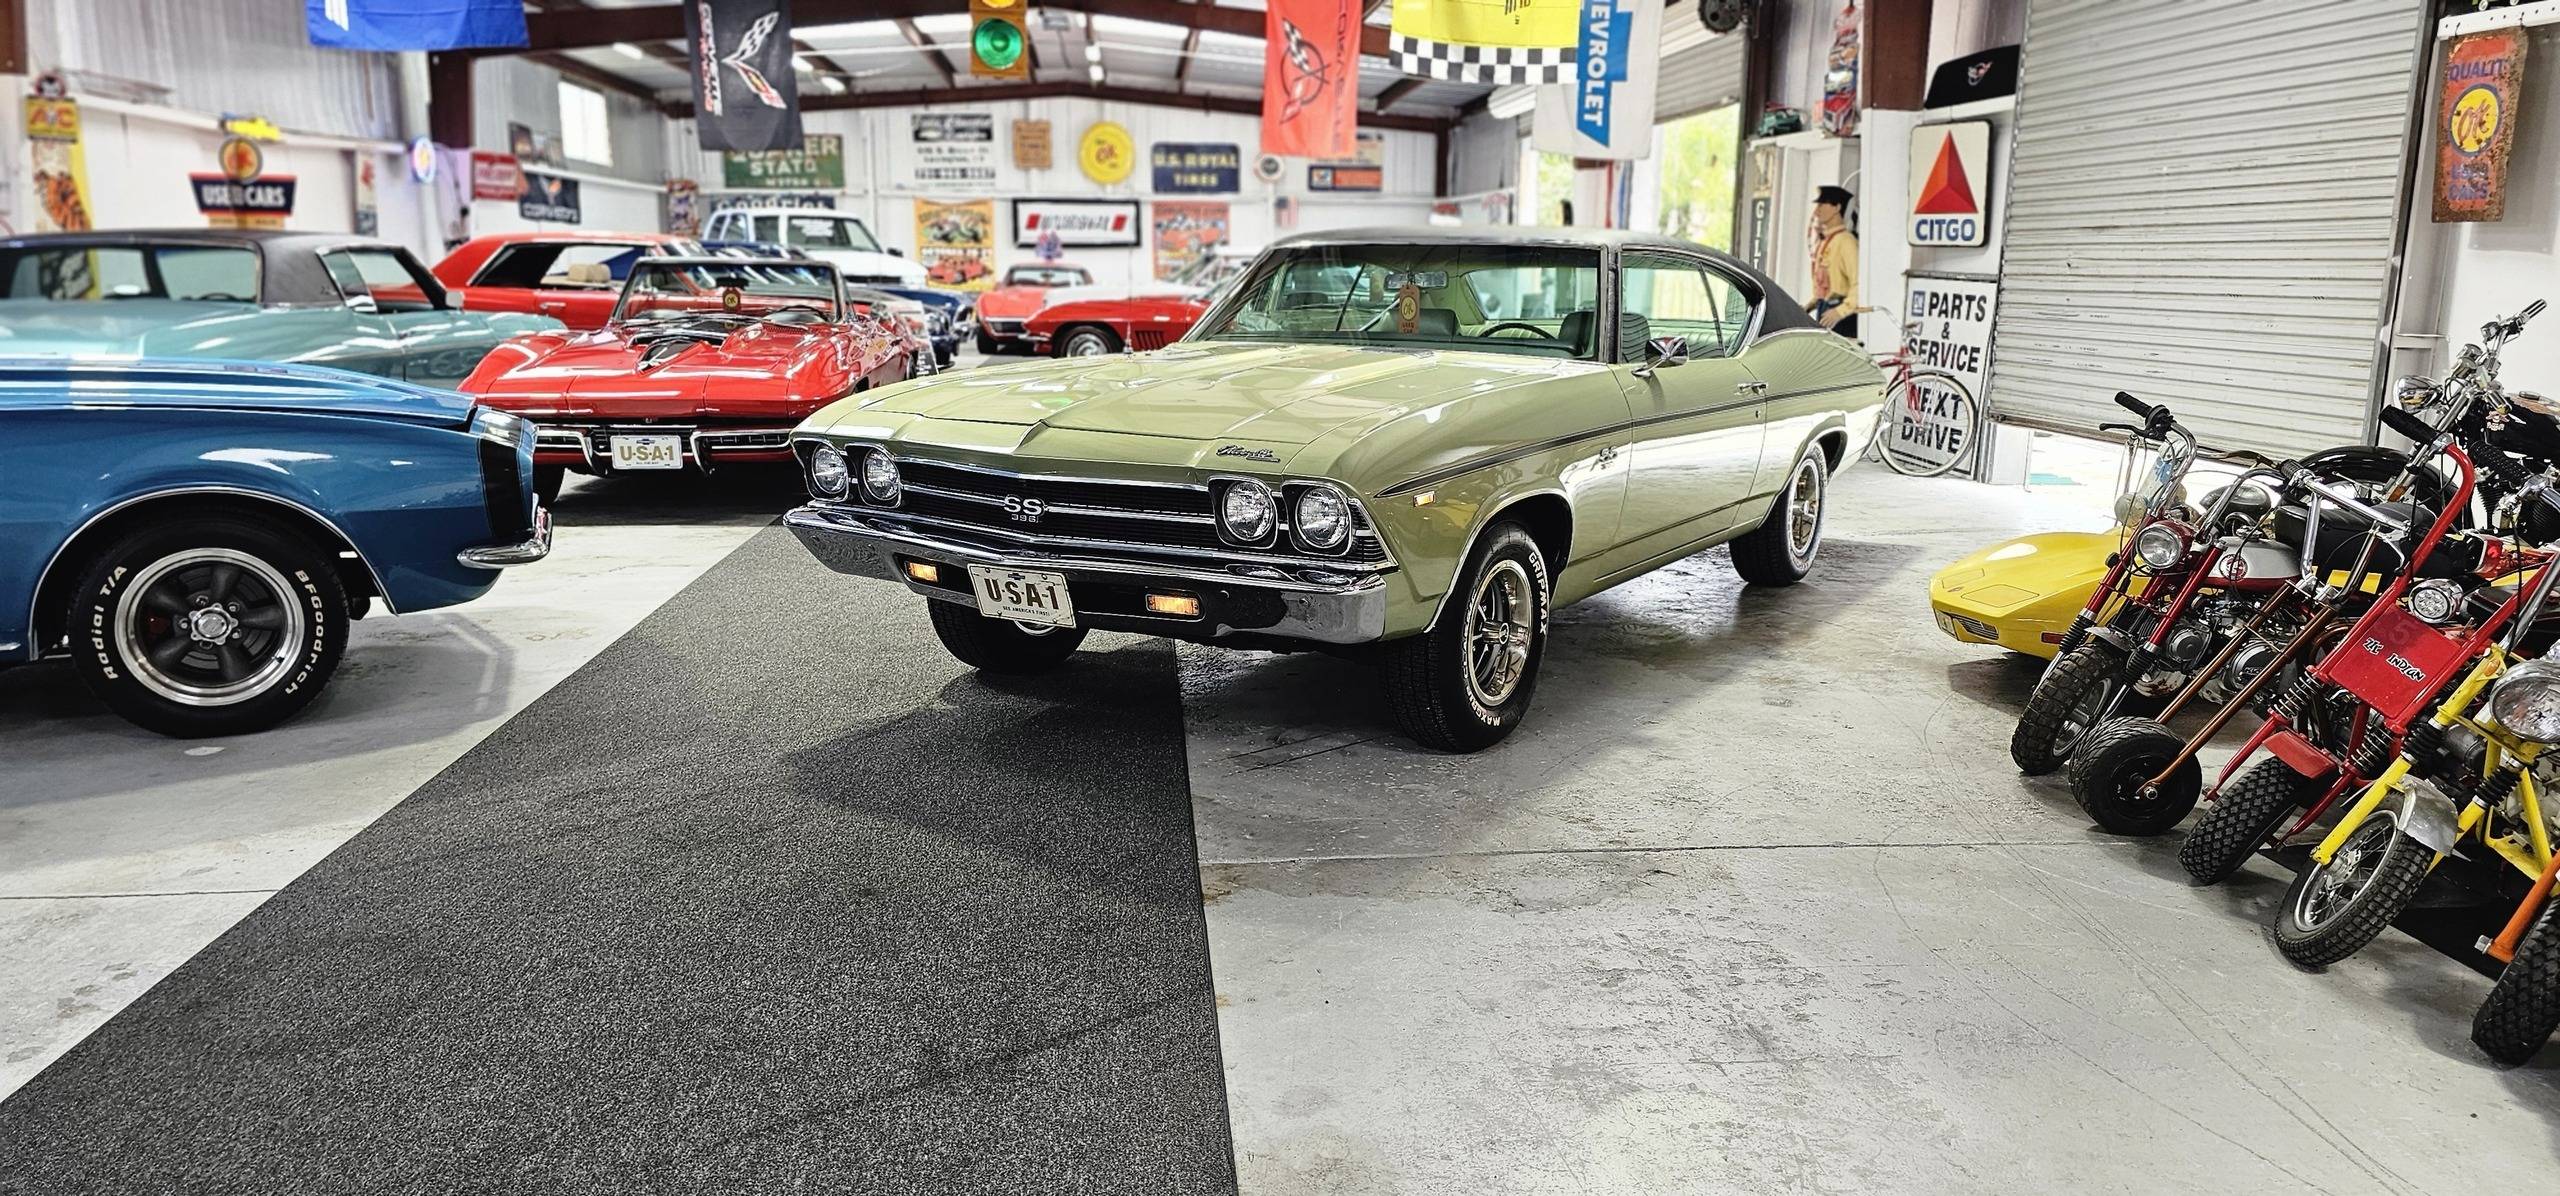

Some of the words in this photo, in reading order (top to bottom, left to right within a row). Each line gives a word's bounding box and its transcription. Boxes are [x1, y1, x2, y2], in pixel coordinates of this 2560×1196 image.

[700, 2, 722, 116] CORVETTE
[1583, 0, 1613, 127] EVROLET
[2449, 58, 2505, 81] QUALIT
[2457, 98, 2491, 146] OK
[1185, 153, 1238, 168] ROYAL
[2451, 163, 2490, 181] US
[201, 185, 244, 206] USED
[245, 186, 285, 207] CARS
[1173, 174, 1219, 187] TIRES
[1915, 218, 1976, 242] CITGO
[1928, 291, 1988, 322] PARTS
[1941, 321, 1950, 340] &
[1908, 337, 1981, 374] SERVICE
[1908, 383, 1963, 421] NEXT
[1901, 415, 1963, 454] DRIVE
[1003, 495, 1043, 516] SS
[1011, 513, 1037, 523] 396
[100, 566, 128, 597] T/A
[1528, 551, 1548, 636] GRIPMAX
[91, 604, 119, 680] Radial
[285, 569, 324, 695] BFGoodrich
[2386, 652, 2426, 683] INDIAN
